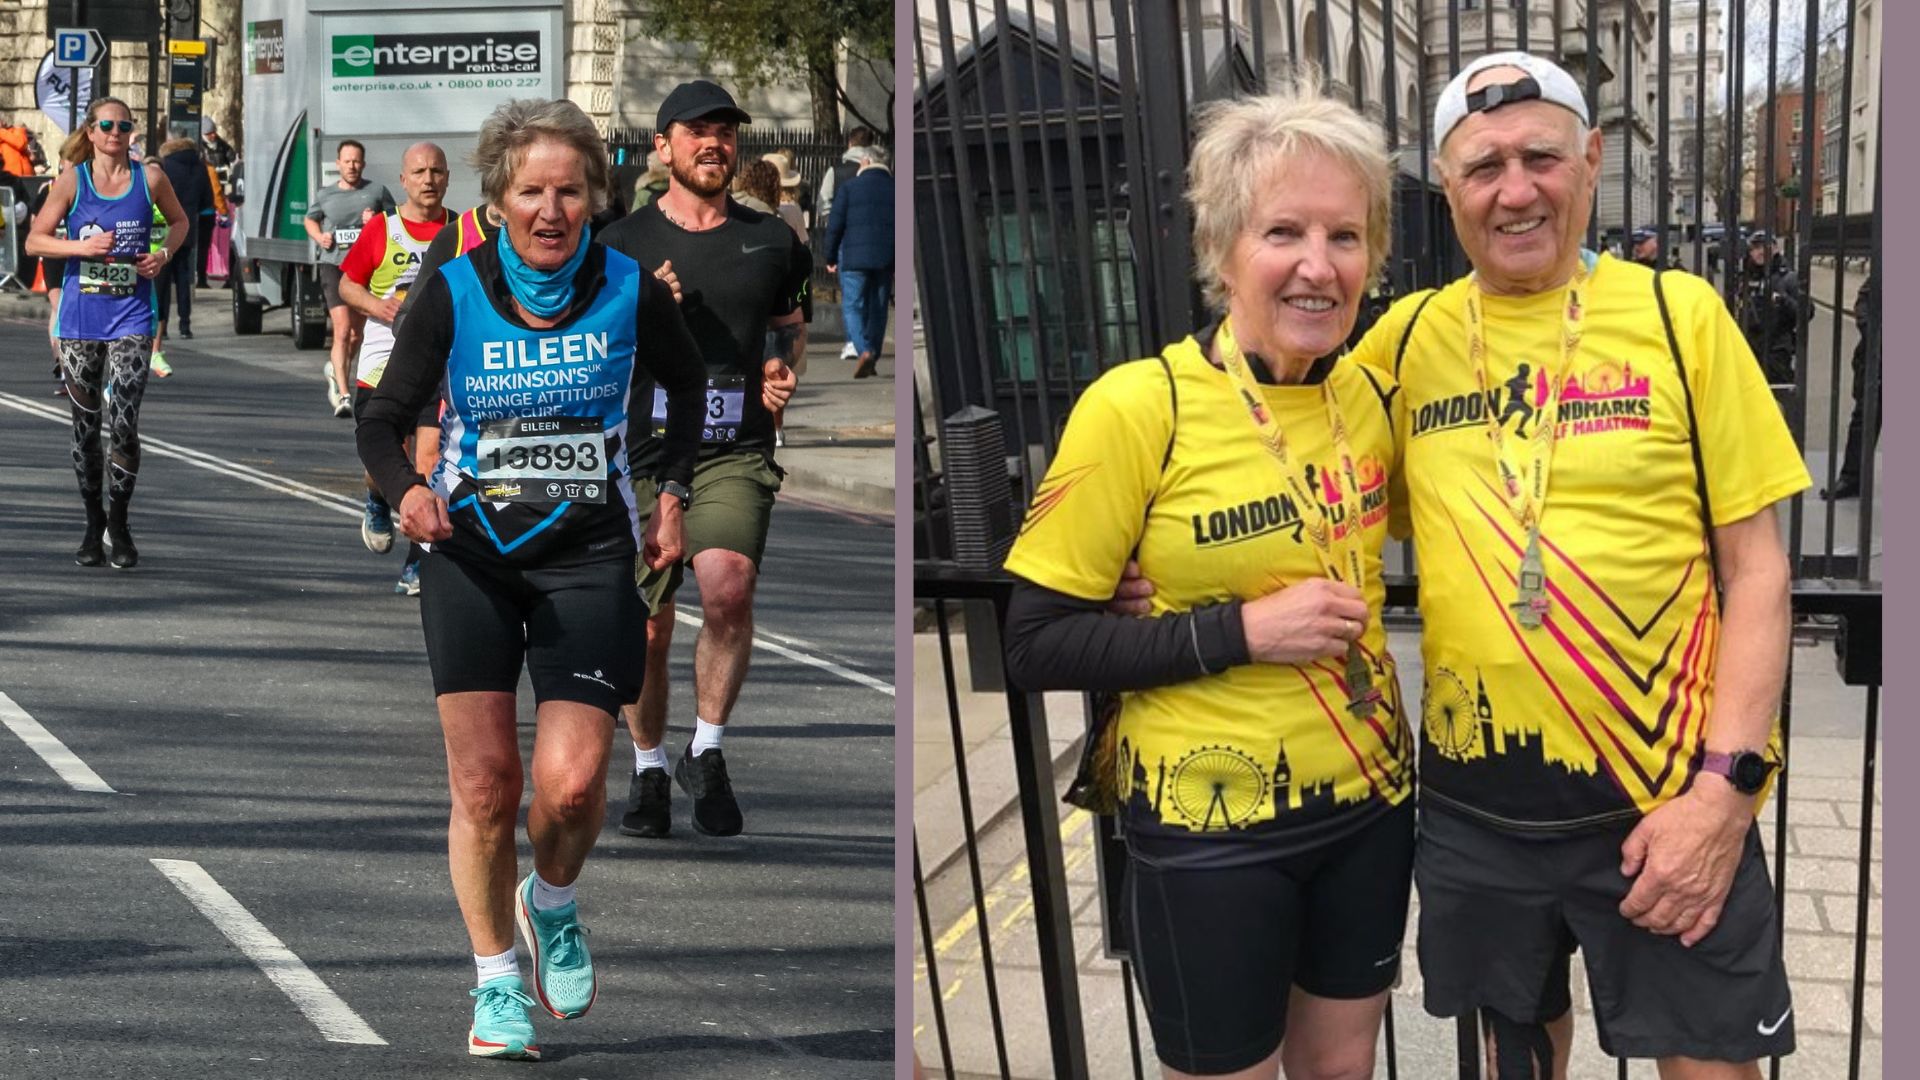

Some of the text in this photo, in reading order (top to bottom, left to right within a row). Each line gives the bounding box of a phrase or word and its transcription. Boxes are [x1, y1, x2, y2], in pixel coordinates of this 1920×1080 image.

[64, 36, 81, 59] P
[332, 38, 538, 70] enterprise
[466, 62, 538, 73] rent-a-car
[332, 78, 541, 92] enterprise.co.uk 0800 800 227
[115, 220, 140, 229] GREAT
[392, 252, 427, 266] CA
[88, 266, 130, 282] 5423
[482, 332, 609, 370] EILEEN
[466, 392, 533, 409] CHANGE
[470, 409, 504, 422] FIND
[508, 409, 517, 418] A
[1411, 388, 1502, 437] LONDON
[1536, 399, 1650, 426] NDMARKS
[521, 421, 560, 432] EILEEN
[487, 442, 600, 472] 13893
[1193, 493, 1299, 545] LONDON
